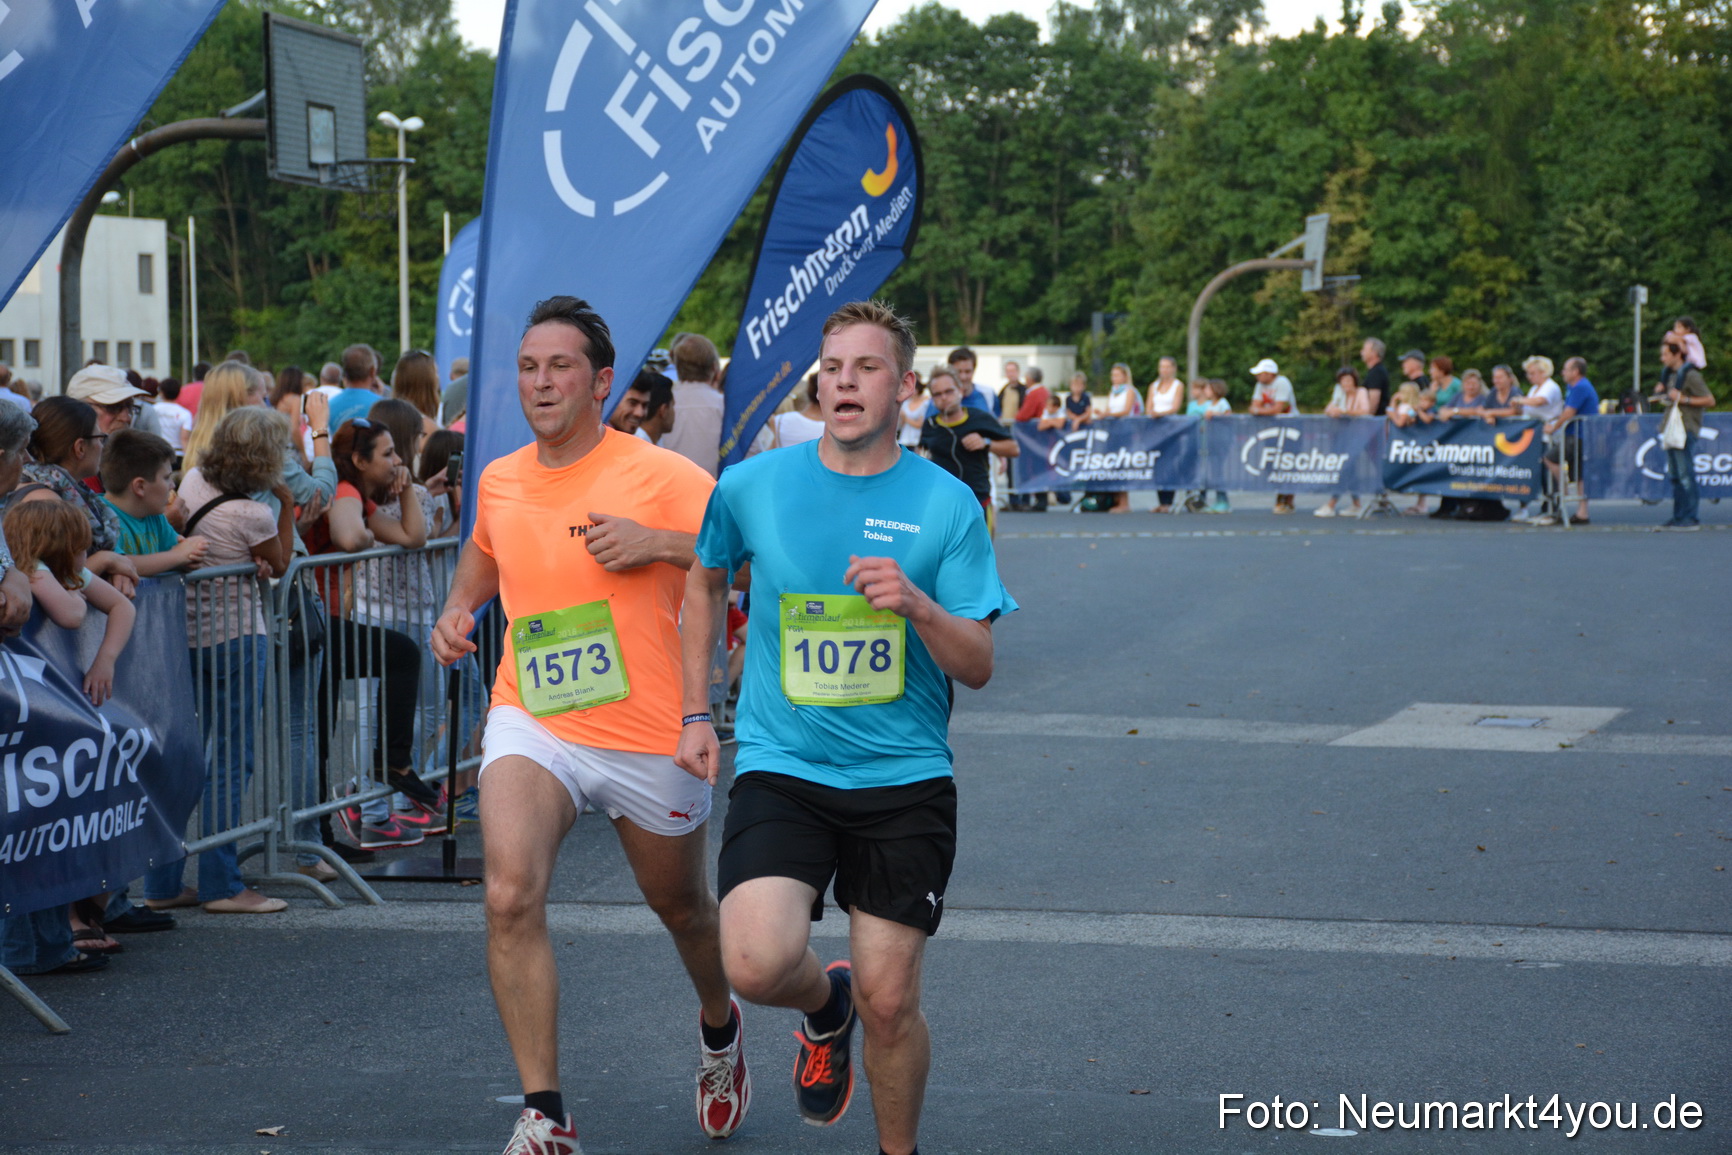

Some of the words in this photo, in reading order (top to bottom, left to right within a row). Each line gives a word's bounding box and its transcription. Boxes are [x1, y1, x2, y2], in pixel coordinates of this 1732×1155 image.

[824, 253, 857, 297] Druck
[874, 186, 913, 242] Medien
[746, 204, 870, 360] Frischmann
[1069, 447, 1161, 471] Fischer
[1259, 447, 1349, 471] Fischer
[1388, 439, 1495, 465] Frischmann
[1074, 469, 1153, 481] AUTOMOBILE
[1266, 470, 1340, 484] AUTOMOBILE
[1448, 463, 1475, 476] Druck
[1475, 465, 1494, 477] und
[1494, 465, 1532, 479] Medien
[863, 530, 893, 542] Tobias
[874, 519, 921, 534] PFLEIDERER
[842, 617, 865, 627] 2016
[526, 643, 611, 689] 1573
[794, 638, 892, 675] 1078
[548, 691, 574, 701] Andreas
[574, 686, 595, 695] Blank
[814, 681, 839, 691] Tobias
[840, 683, 870, 691] Mederer
[0, 795, 149, 865] AUTOMOBILE
